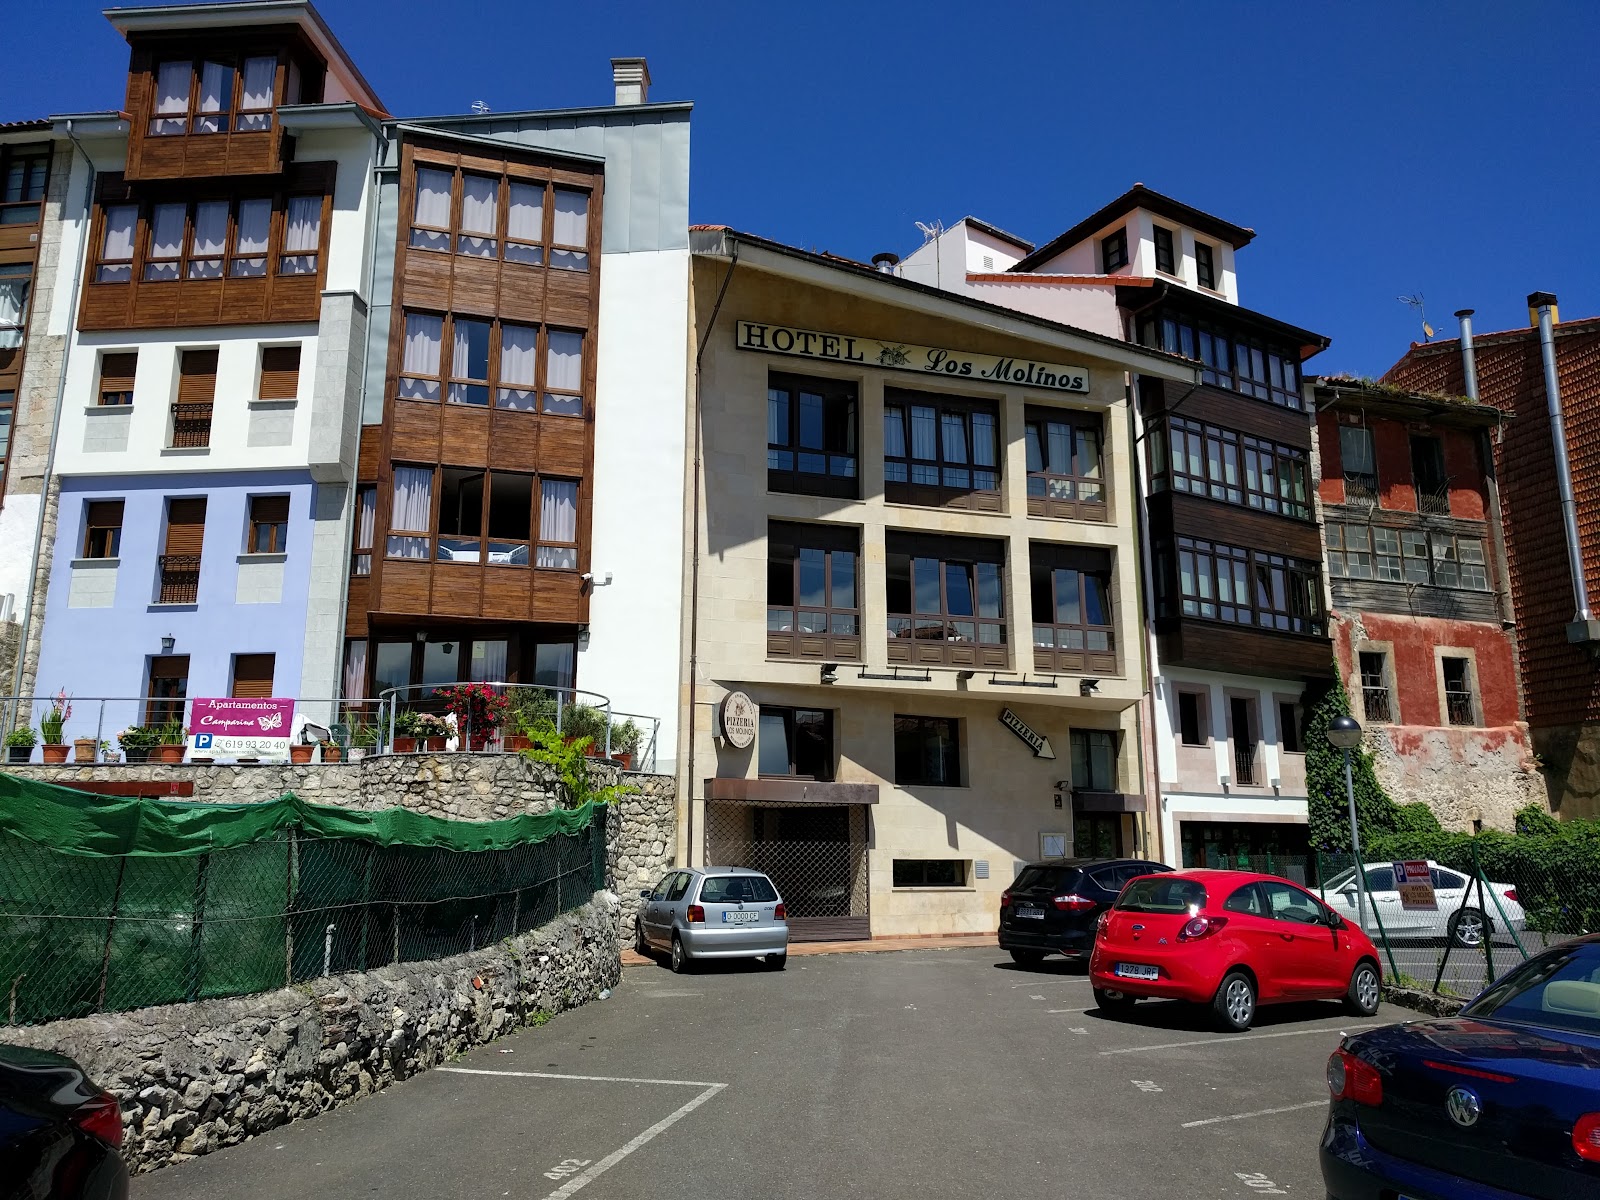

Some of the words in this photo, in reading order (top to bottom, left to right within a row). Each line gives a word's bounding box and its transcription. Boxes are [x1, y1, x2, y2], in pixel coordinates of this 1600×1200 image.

[743, 323, 864, 361] HOTEL
[924, 348, 972, 375] Los
[981, 357, 1084, 390] Molinos
[208, 700, 277, 710] Apartamentos
[726, 716, 754, 727] PIZZERIA
[735, 727, 754, 736] MOLINOS
[1004, 711, 1044, 751] PIZZERIA
[199, 735, 210, 747] P
[225, 740, 243, 749] 619
[245, 740, 257, 749] 93
[259, 741, 272, 749] 20
[273, 741, 286, 750] 40
[1394, 864, 1404, 882] P
[1405, 864, 1428, 874] PRIVADO
[1121, 964, 1140, 974] 1378
[1141, 966, 1158, 977] JRF
